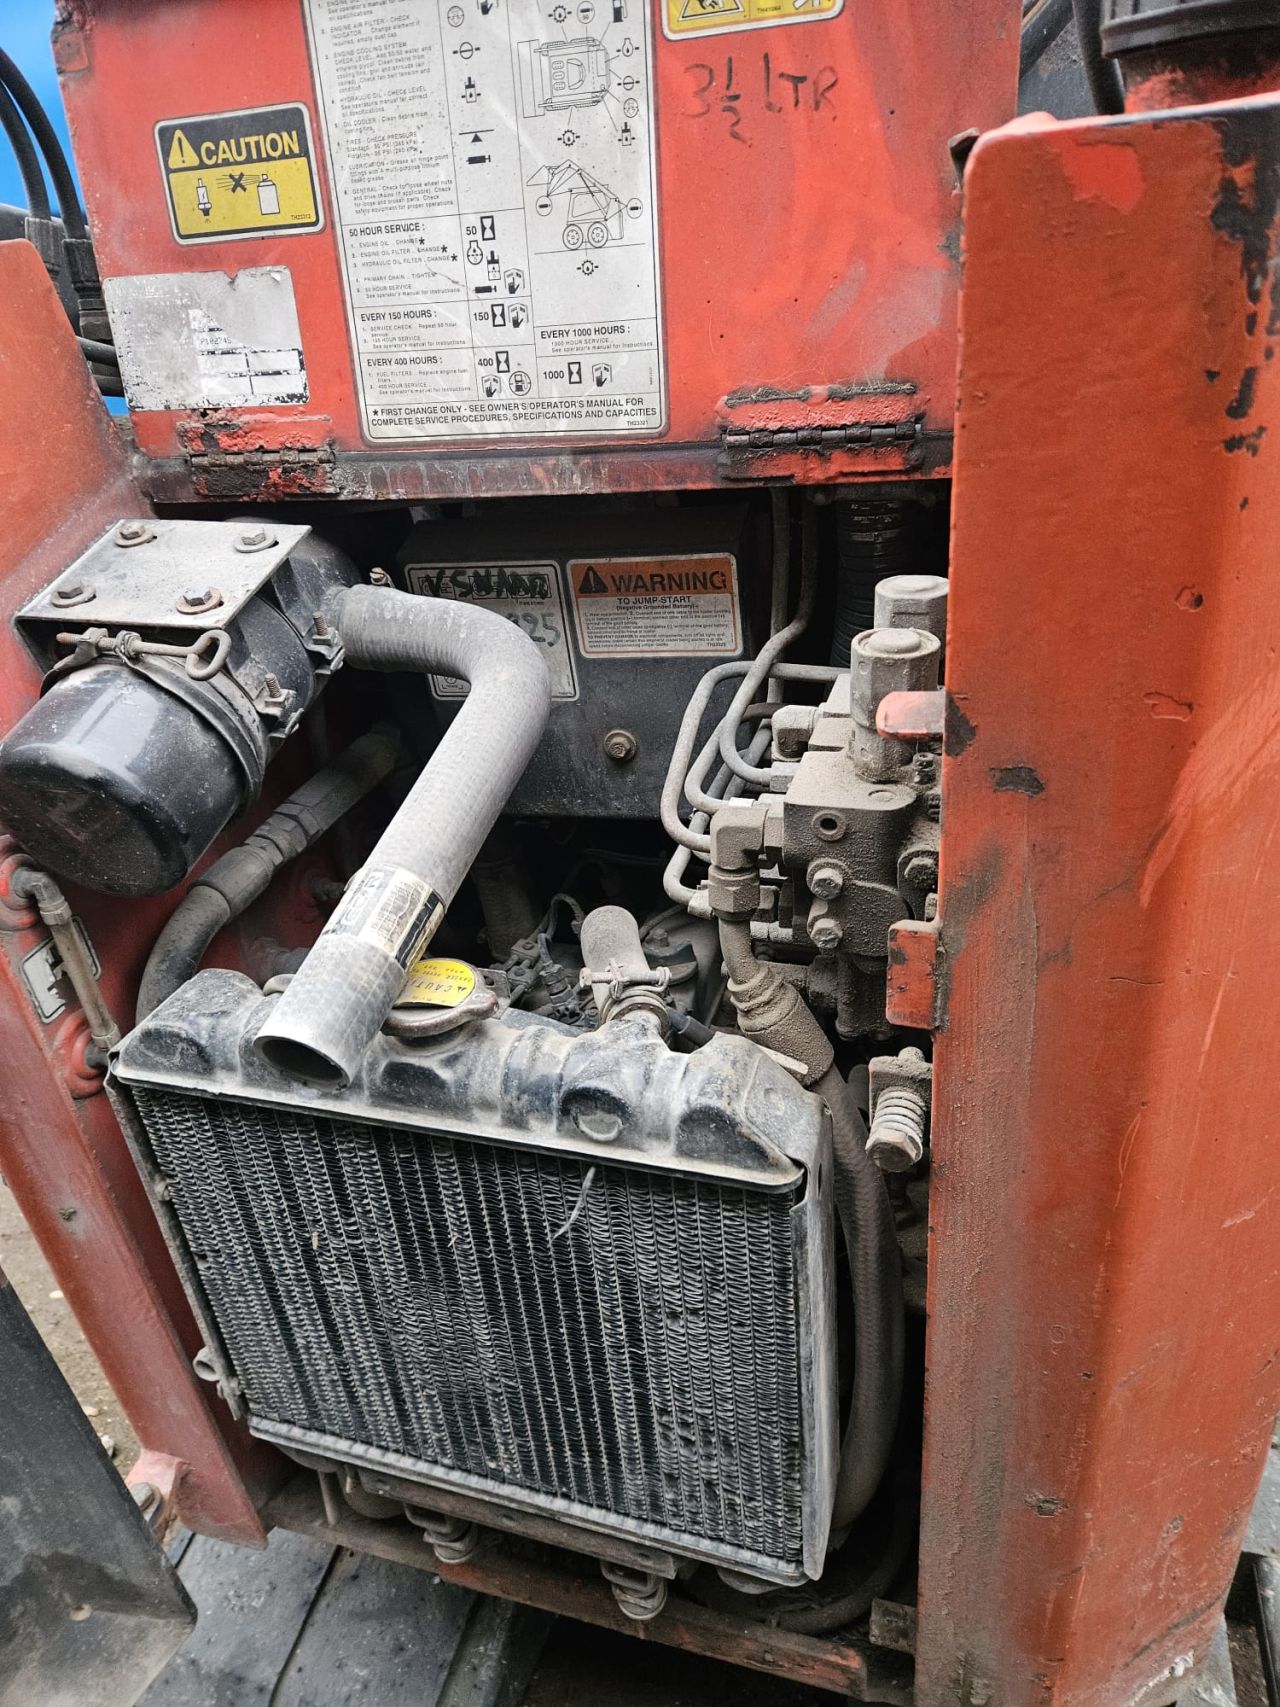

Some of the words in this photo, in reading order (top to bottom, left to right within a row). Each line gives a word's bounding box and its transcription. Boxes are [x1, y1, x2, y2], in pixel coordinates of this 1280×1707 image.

[762, 52, 839, 113] LTR
[200, 130, 300, 166] CAUTION
[350, 228, 358, 236] 50
[360, 225, 383, 236] HOUR
[384, 222, 420, 234] SERVICE
[466, 226, 477, 236] 50
[359, 240, 378, 248] ENGINE
[396, 238, 418, 246] CHANGE
[360, 250, 380, 258] ENGINE
[392, 247, 411, 256] FILTER
[417, 245, 440, 254] CHANGE
[362, 258, 391, 268] HYDRAULIC
[392, 258, 402, 266] OIL
[403, 256, 422, 265] FILTER
[426, 254, 451, 263] CHANGE
[364, 274, 388, 282] PRIMARY
[388, 272, 405, 280] CHAIN
[389, 283, 412, 291] SERVICE
[361, 312, 386, 322] EVERY
[388, 311, 402, 320] 150
[404, 309, 432, 319] HOURS
[473, 311, 490, 322] 150
[540, 330, 570, 339] EVERY
[572, 328, 592, 336] 1000
[594, 326, 626, 336] HOURS
[367, 358, 392, 368] EVERY
[394, 357, 408, 366] 400
[409, 356, 438, 366] HOURS
[478, 358, 494, 367] 400
[391, 370, 412, 378] FILTERS
[542, 370, 565, 380] 1000
[381, 408, 403, 416] FIRST
[404, 406, 438, 416] CHANGE
[440, 405, 462, 414] ONLY
[469, 404, 486, 413] SEE
[487, 402, 527, 412] OWNER'S
[528, 400, 584, 410] OPERATOR'S
[586, 398, 624, 408] MANUAL
[626, 398, 644, 406] FOR
[372, 417, 414, 426] COMPLETE
[415, 416, 450, 425] SERVICE
[451, 413, 511, 424] PROCEDURES,
[512, 409, 583, 420] SPECIFICATIONS
[584, 409, 604, 418] AND
[605, 407, 657, 418] CAPACITIES
[612, 570, 727, 592] WARNING
[632, 596, 692, 604] JUMP-START
